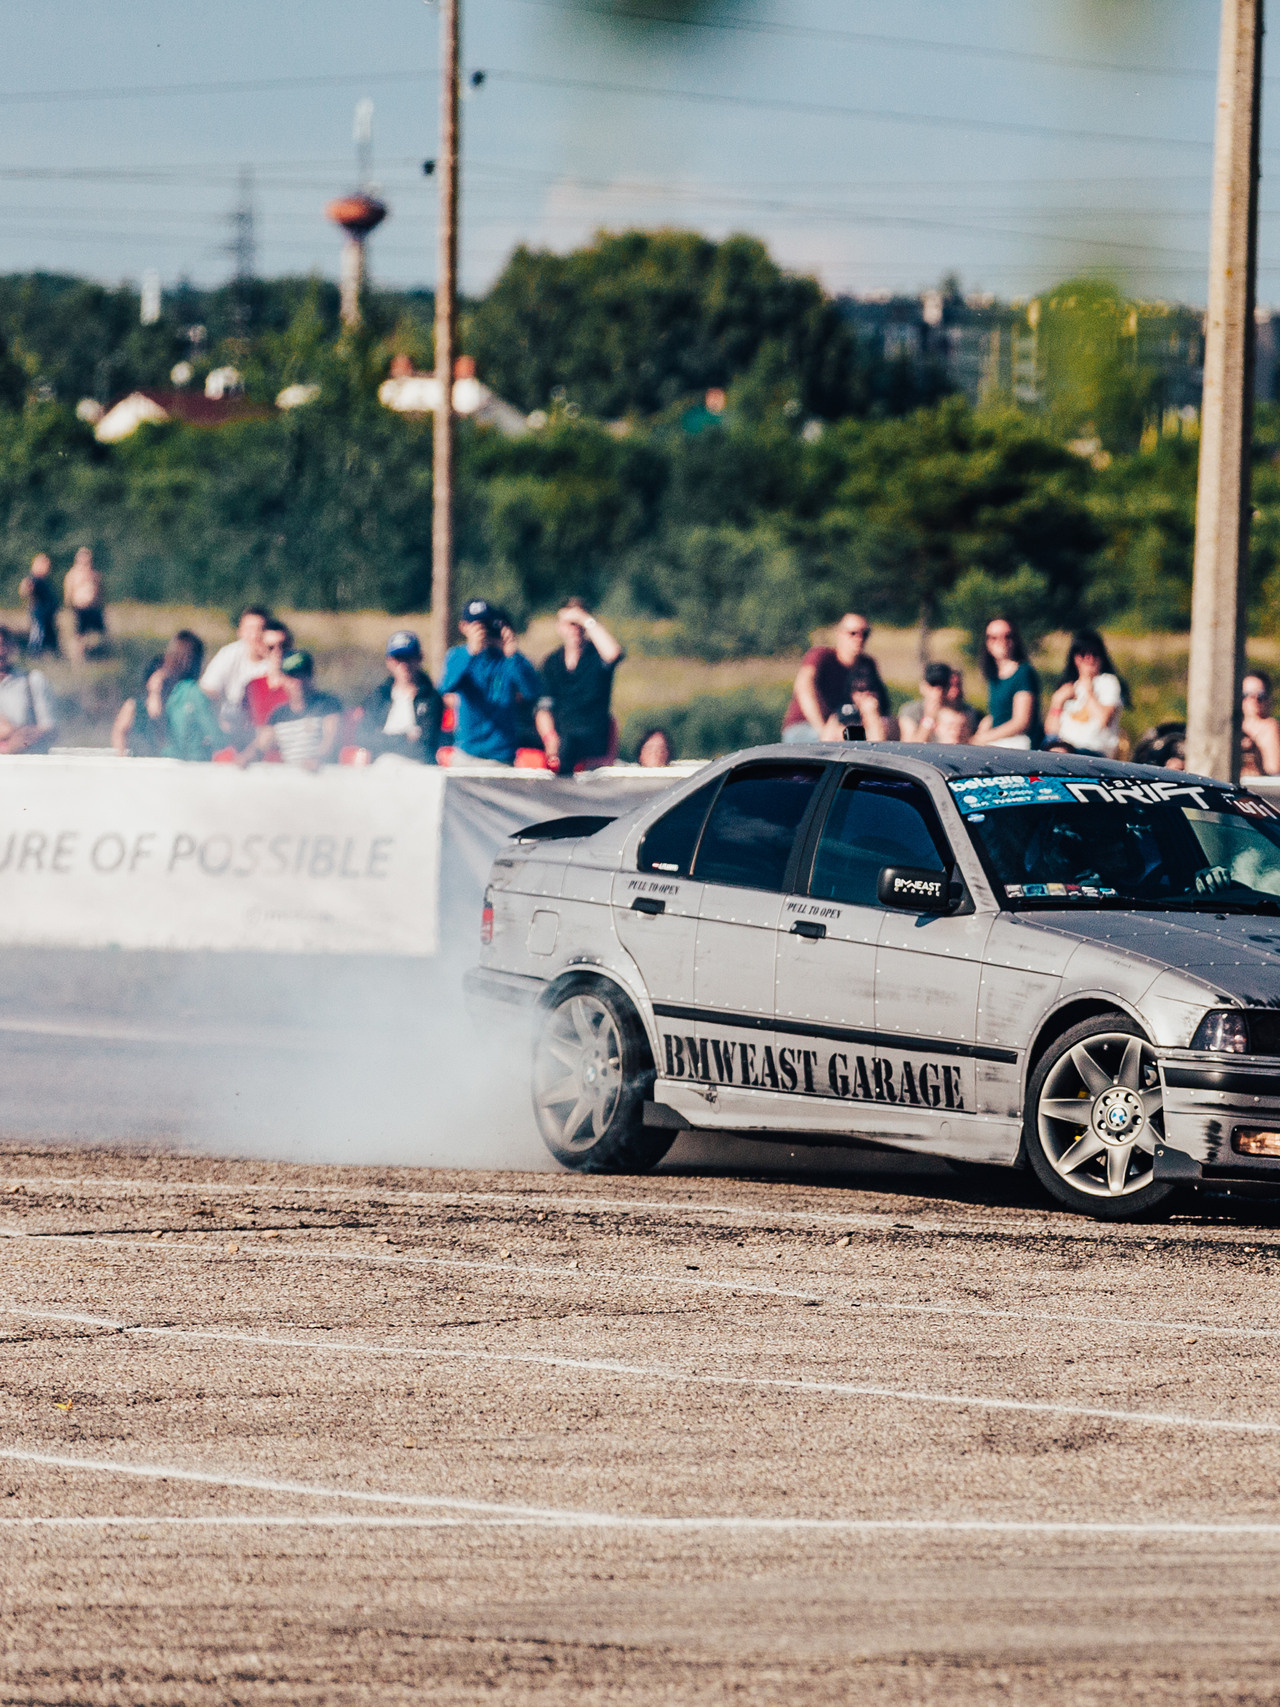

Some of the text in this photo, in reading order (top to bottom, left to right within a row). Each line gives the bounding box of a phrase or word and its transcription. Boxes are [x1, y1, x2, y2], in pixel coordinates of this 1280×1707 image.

[1065, 782, 1210, 810] DRIFT
[90, 831, 157, 873] OF
[165, 832, 395, 880] POSSIBLE
[628, 879, 681, 896] PULL TO OPEN
[786, 902, 844, 920] PULL TO OPEN
[663, 1034, 965, 1109] BMWEAST GARAGE
